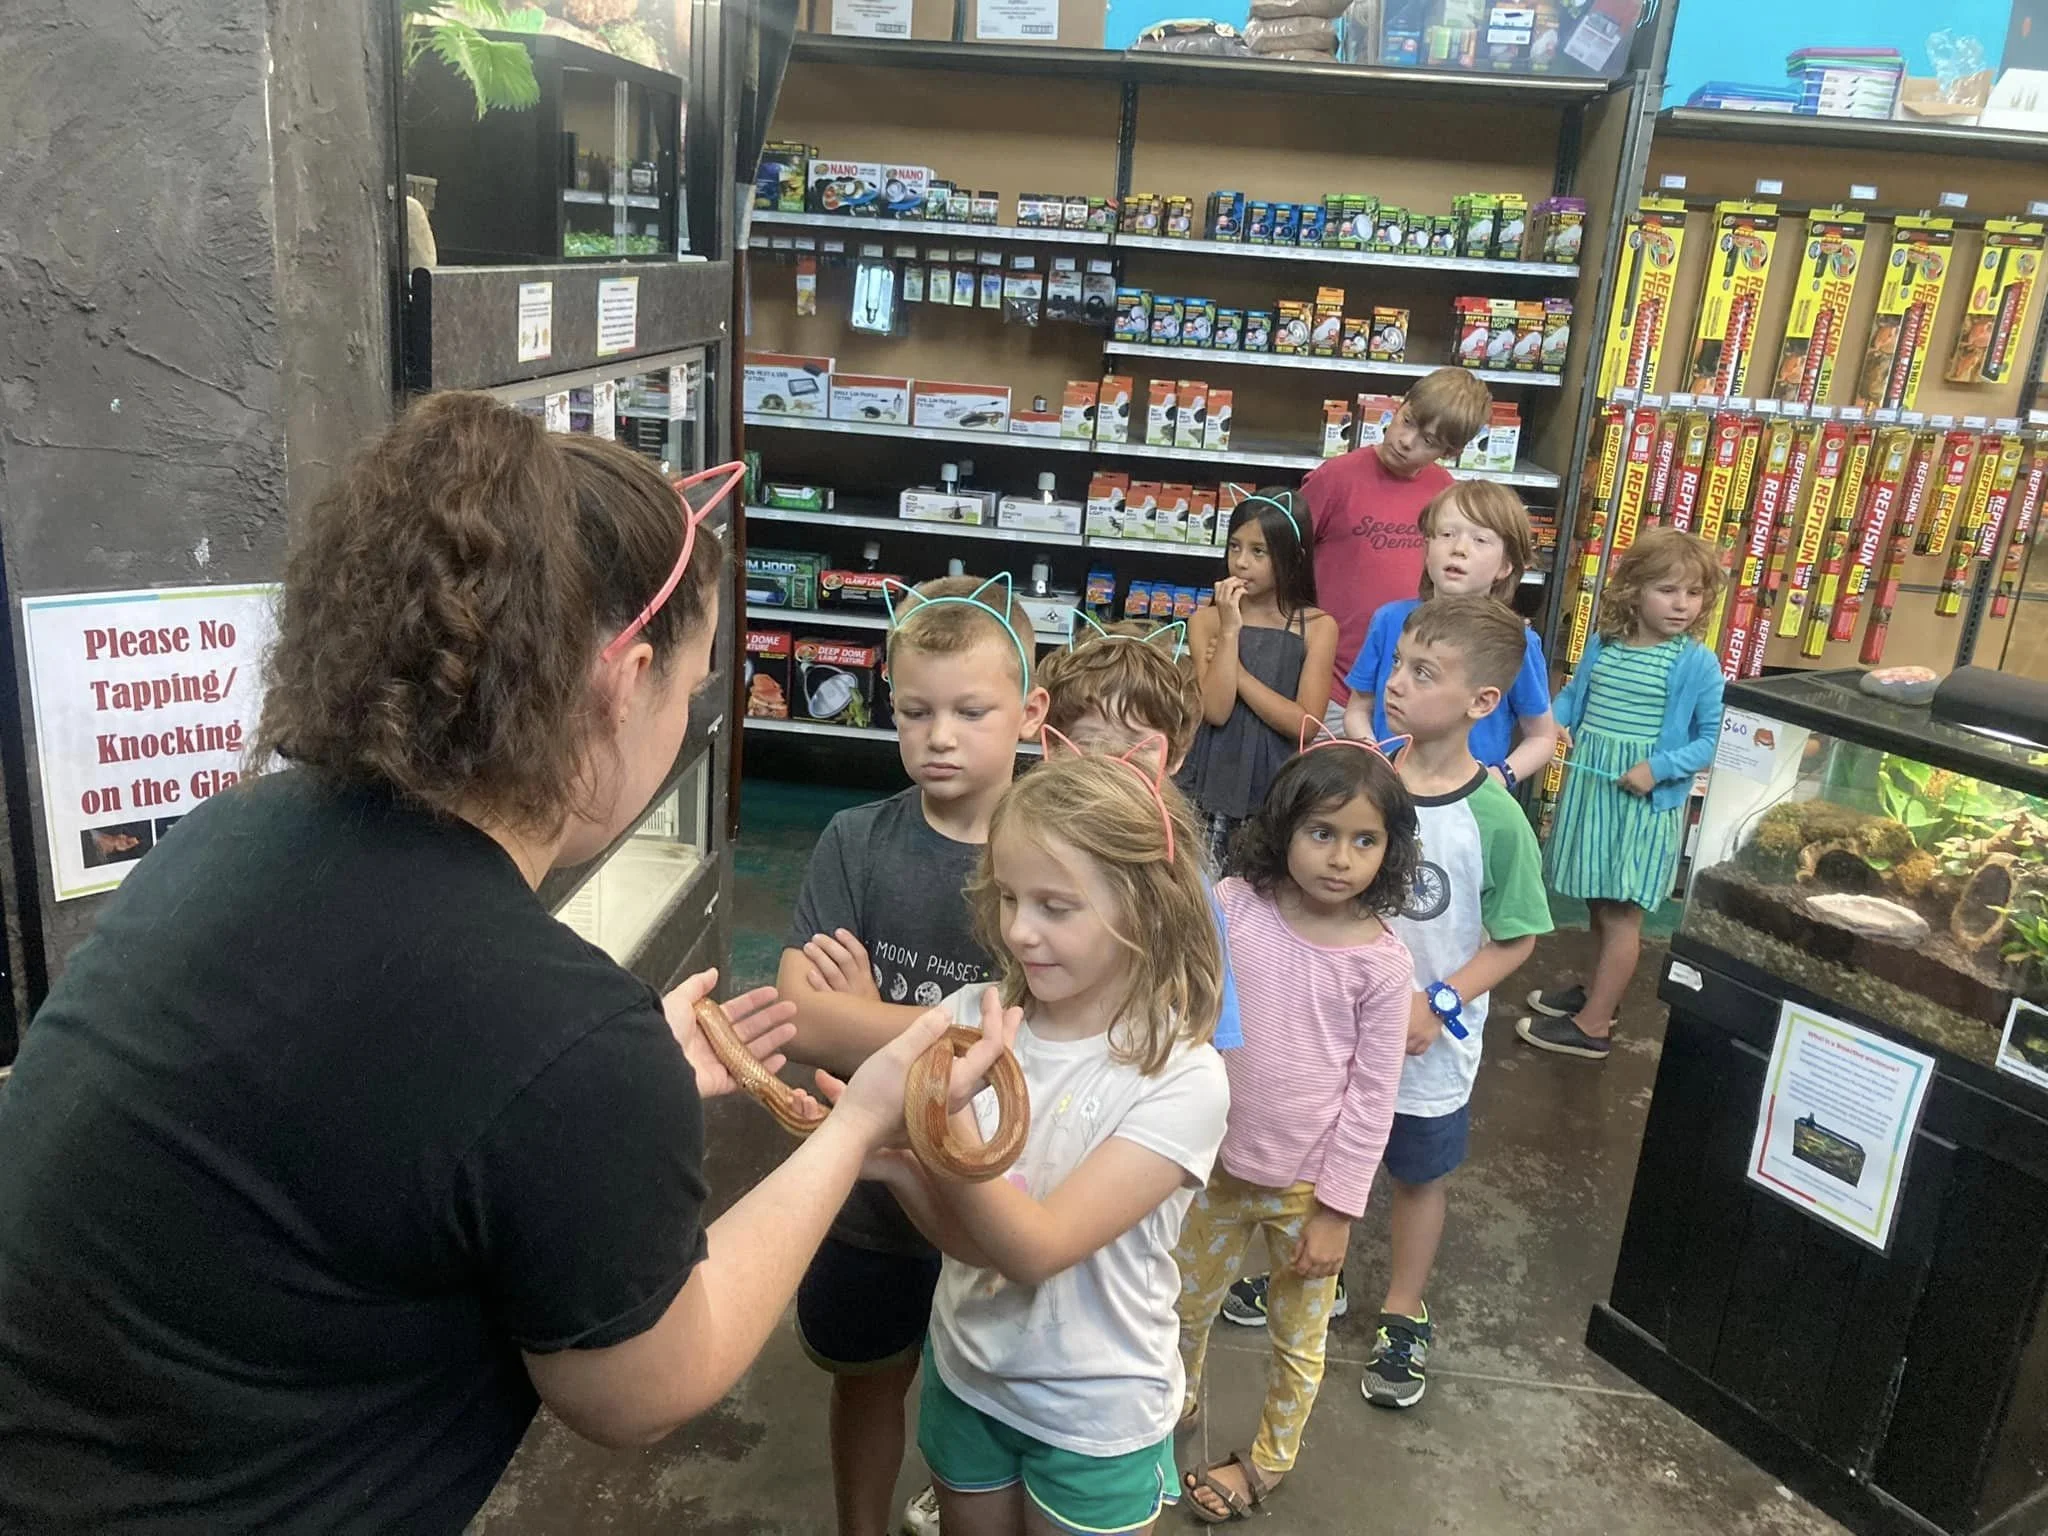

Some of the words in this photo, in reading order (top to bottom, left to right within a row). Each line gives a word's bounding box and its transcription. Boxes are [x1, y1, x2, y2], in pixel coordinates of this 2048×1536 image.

[831, 164, 858, 176] NANO
[897, 169, 923, 181] NANO
[1824, 280, 1851, 360] REPTISUN
[1603, 437, 1618, 486] REPTISUN
[1656, 440, 1673, 496] REPTISUN
[1735, 448, 1753, 497] REPTISUN
[1789, 452, 1806, 504] REPTISUN
[1843, 457, 1864, 509] REPTISUN
[1617, 468, 1644, 549] REPTISUN
[1675, 471, 1698, 533] REPTIS
[1703, 473, 1728, 540] REPTISU
[1908, 461, 1929, 514] REPTISUN
[1972, 467, 1993, 520] REPTISUN
[2020, 469, 2042, 522] REPTISUN
[1370, 534, 1424, 549] Demo
[1750, 478, 1779, 557] REPTISUN
[1800, 483, 1830, 562] REPTISUN
[1858, 487, 1894, 566] REPTISUN
[1930, 492, 1956, 552] REPTISUN
[1980, 495, 2007, 555] REPTISUN
[762, 561, 796, 573] HOOD
[868, 579, 884, 587] LAM
[84, 625, 190, 661] Please
[199, 619, 236, 650] No
[751, 635, 780, 646] DOME
[818, 646, 840, 655] DEEP
[841, 648, 867, 658] DOME
[1573, 605, 1589, 654] REPTISUN
[1723, 627, 1746, 681] REPTIS
[1751, 619, 1770, 670] REPTISUN
[818, 655, 838, 663] LAMP
[90, 667, 238, 711] Tapping/
[96, 720, 243, 764] Knocking
[1723, 718, 1748, 736] $60
[81, 785, 122, 815] on
[131, 778, 180, 807] the
[190, 768, 239, 798] Gla
[875, 940, 918, 969] MOON
[927, 955, 981, 983] PHASES
